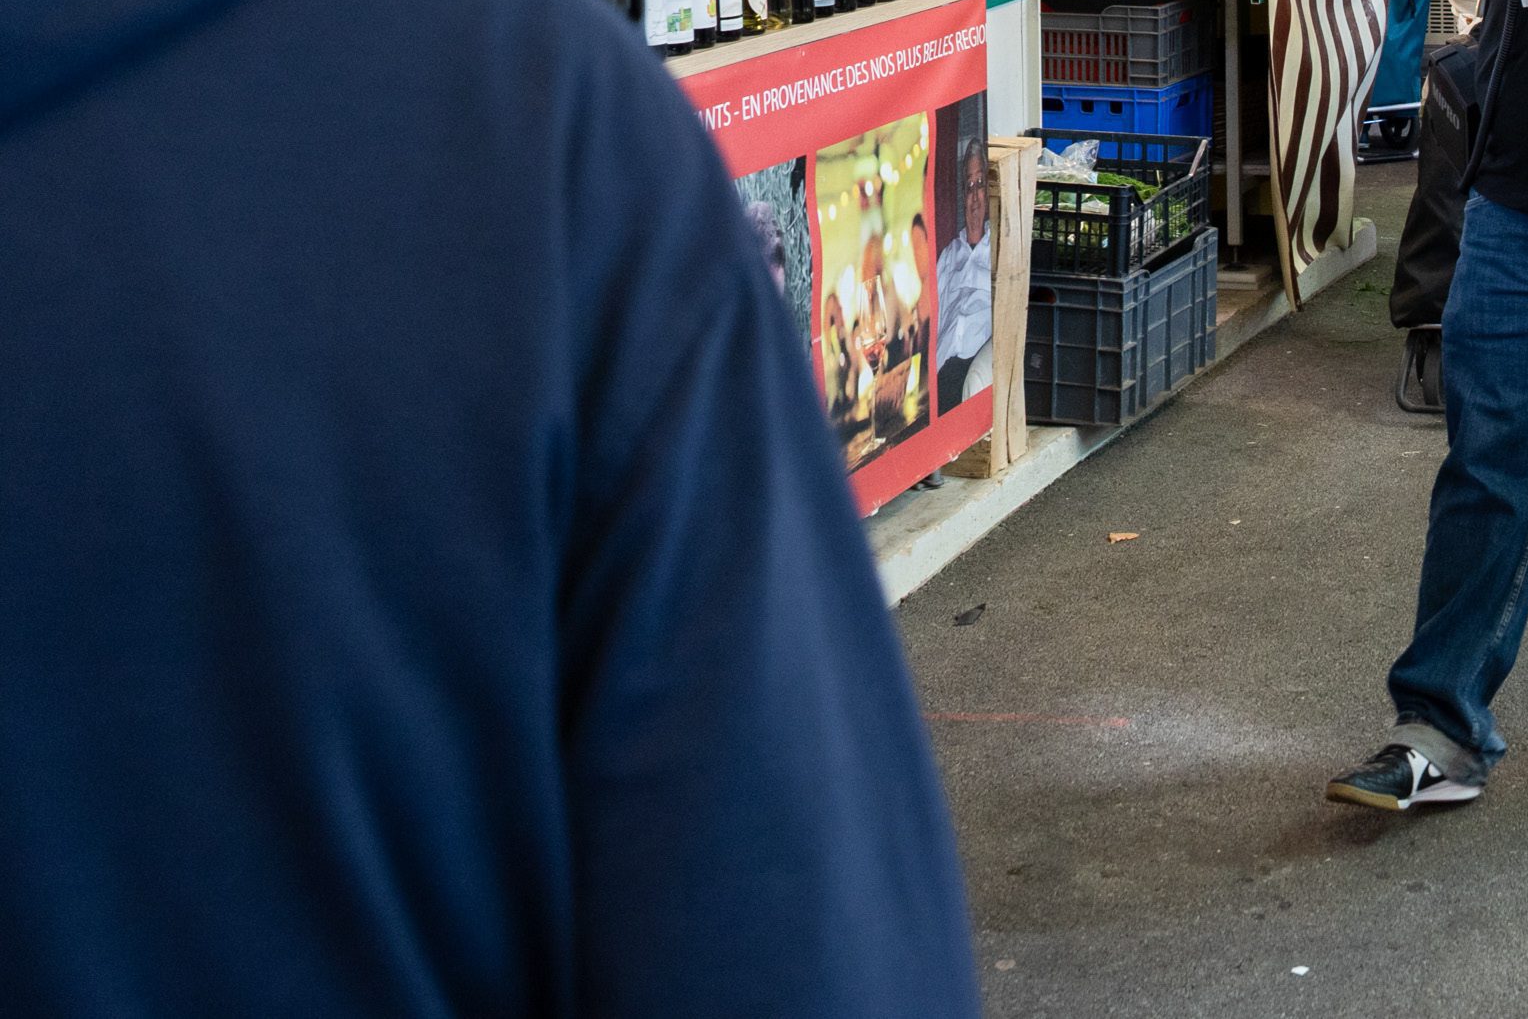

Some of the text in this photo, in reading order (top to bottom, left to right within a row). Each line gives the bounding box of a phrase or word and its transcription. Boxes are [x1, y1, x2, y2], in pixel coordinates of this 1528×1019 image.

[741, 93, 762, 122] EN
[763, 67, 845, 114] PROVENANCE
[846, 60, 870, 89] DES
[870, 53, 896, 81] NOS
[896, 43, 922, 74] PLUS
[922, 34, 955, 64] BELLES
